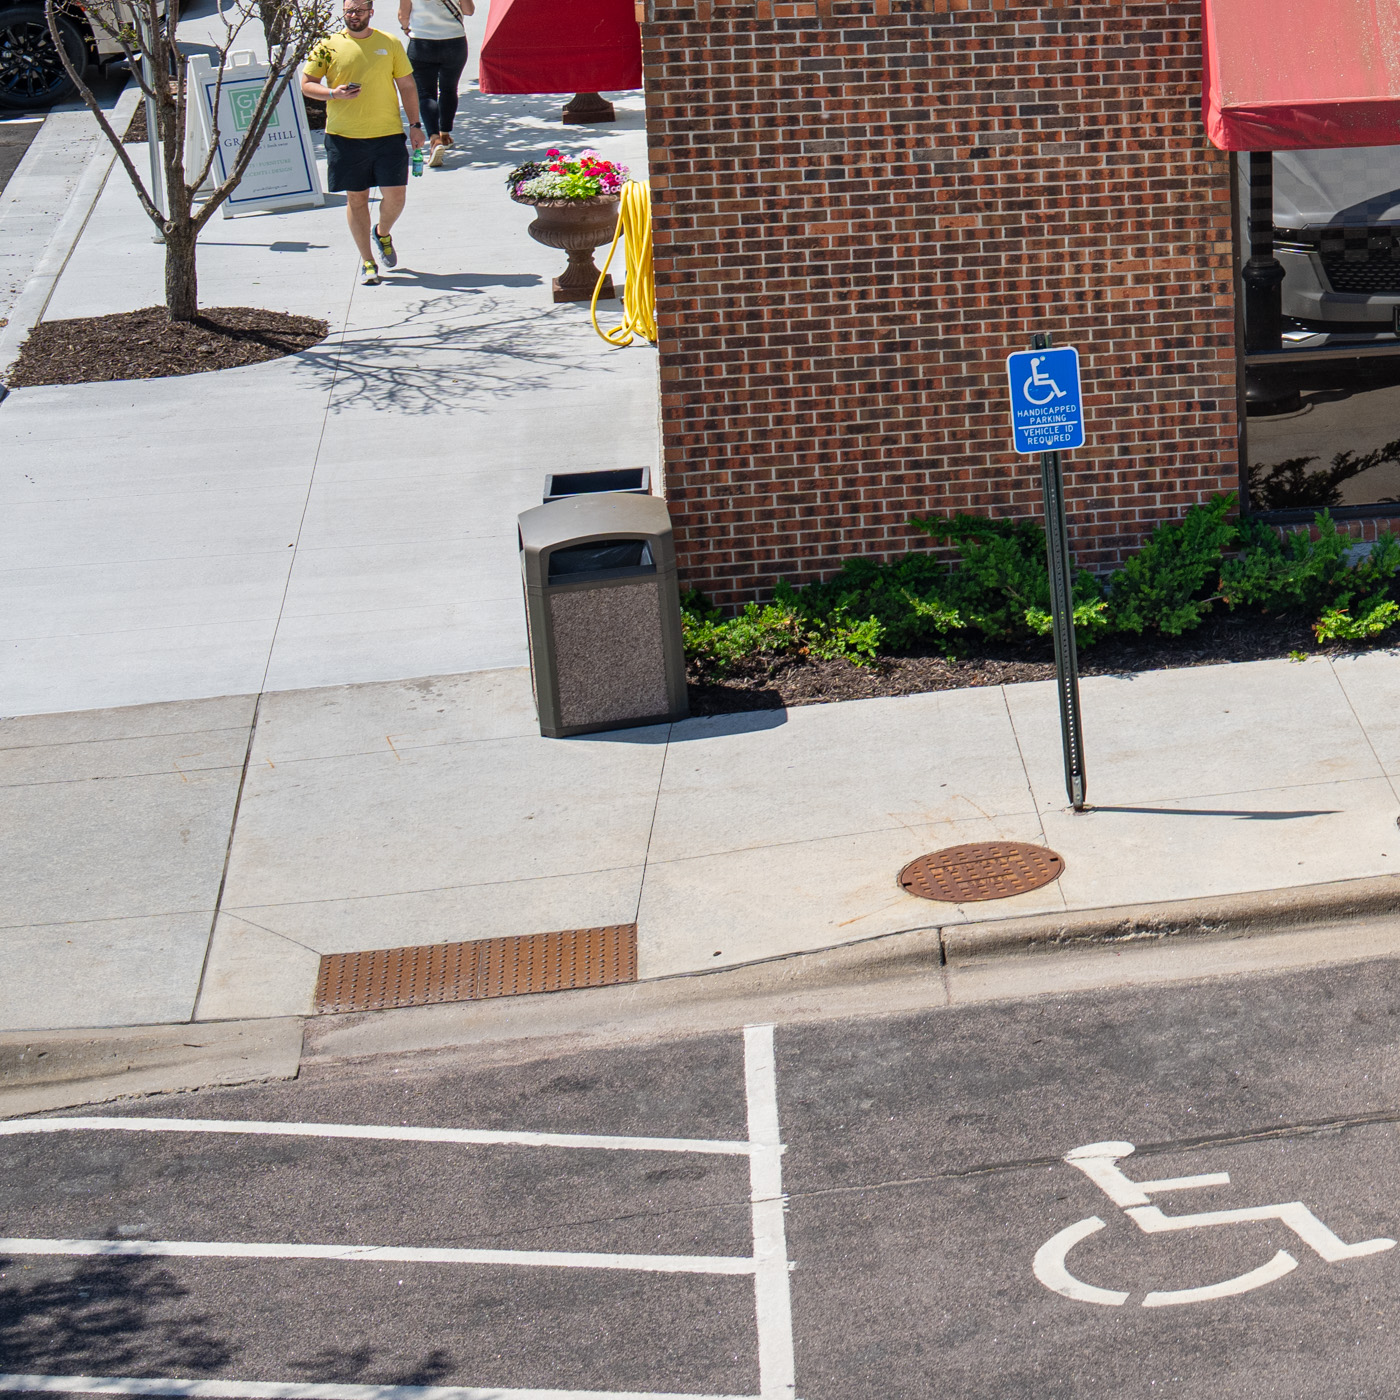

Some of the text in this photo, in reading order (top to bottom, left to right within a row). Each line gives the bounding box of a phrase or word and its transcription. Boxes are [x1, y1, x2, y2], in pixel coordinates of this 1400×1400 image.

[268, 130, 296, 141] HILL
[1017, 404, 1077, 418] HANDICAPPED
[1030, 414, 1067, 424] PARKING
[1023, 425, 1074, 437] VEHICLE ID
[1027, 434, 1071, 445] REQUIRED
